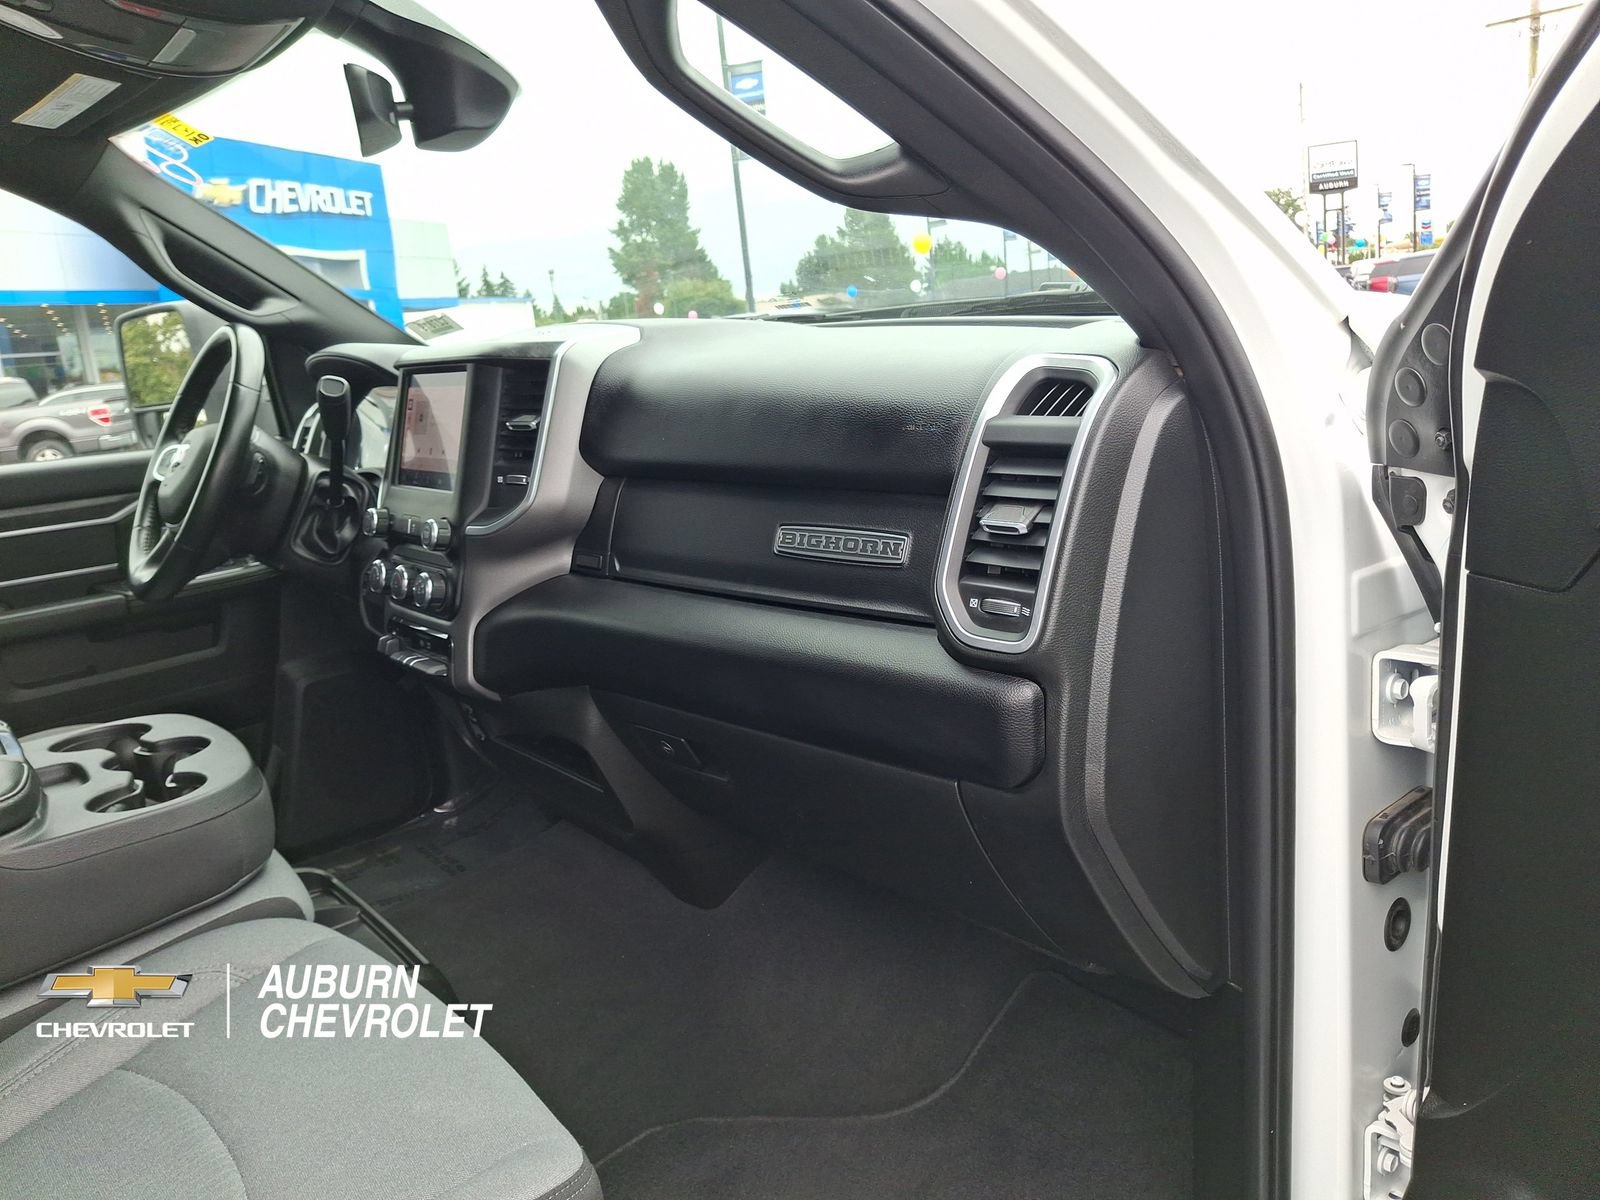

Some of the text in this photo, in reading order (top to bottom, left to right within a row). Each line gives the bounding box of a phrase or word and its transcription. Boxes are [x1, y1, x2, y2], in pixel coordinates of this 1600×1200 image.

[248, 177, 373, 217] CHEVROLET
[1318, 180, 1349, 190] AUBURN
[779, 531, 904, 558] BIGHORN
